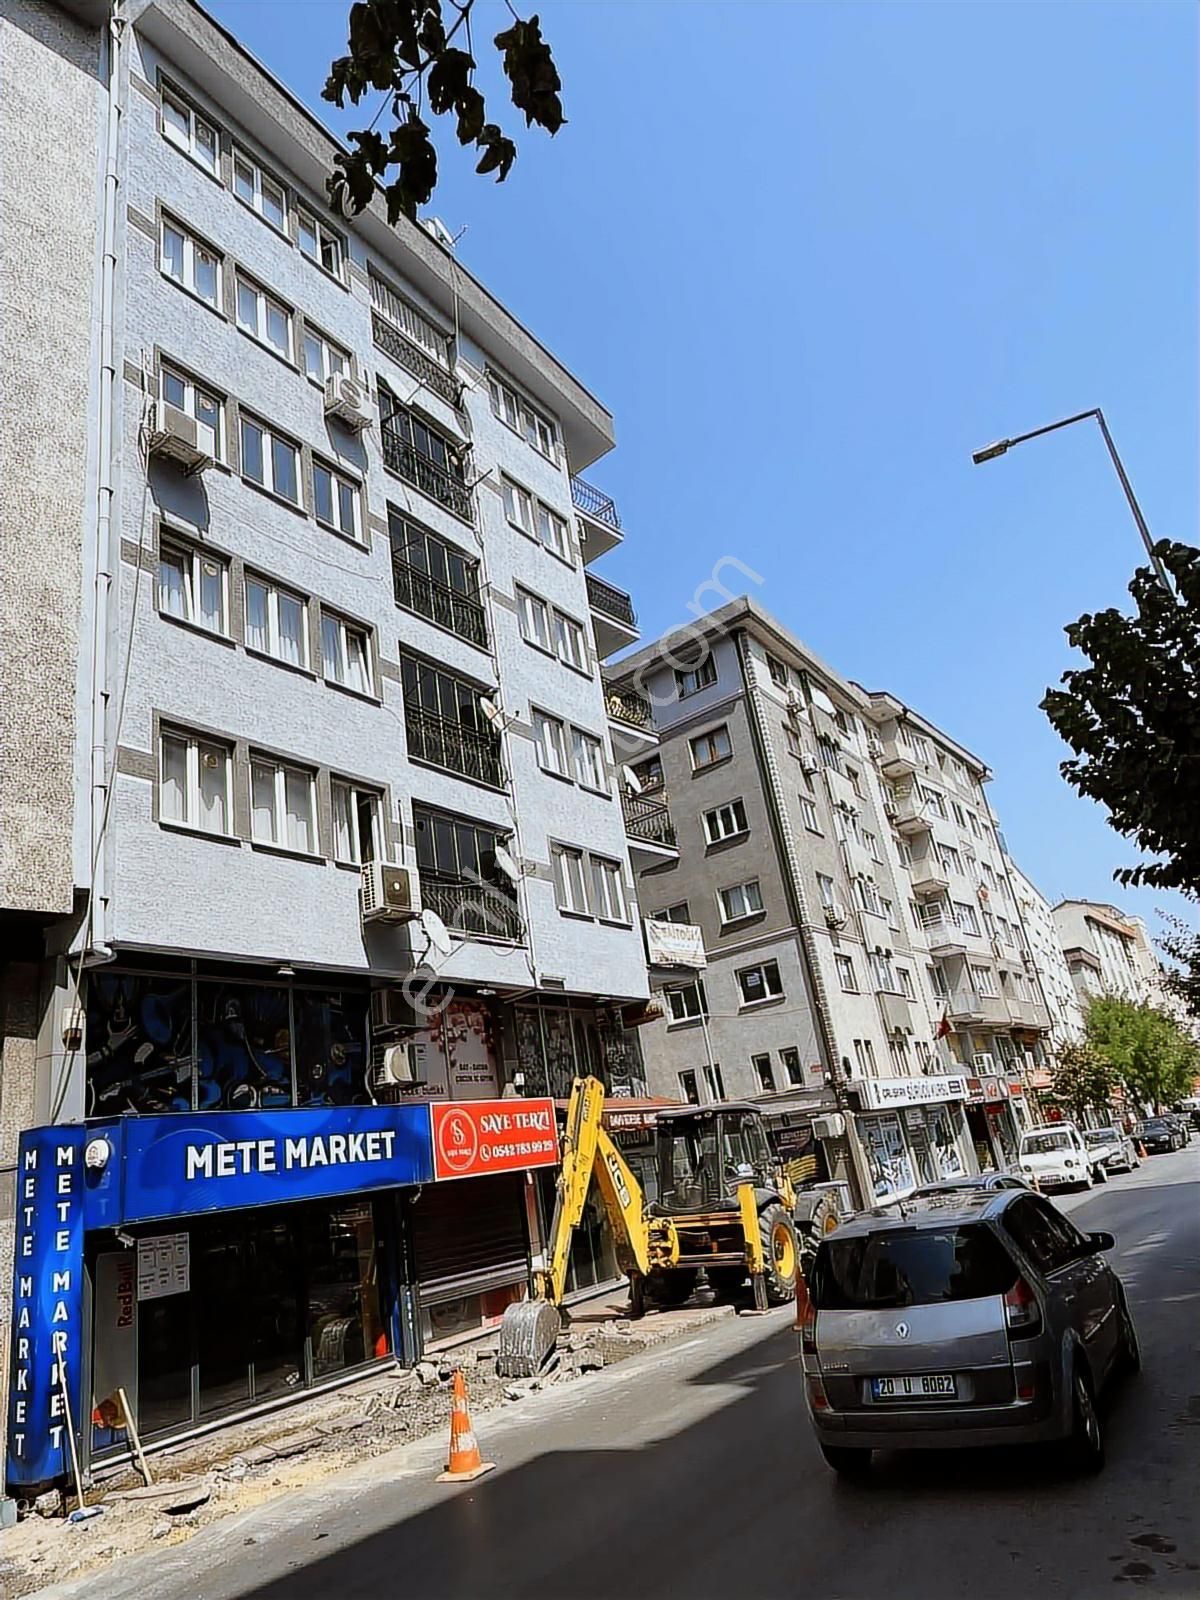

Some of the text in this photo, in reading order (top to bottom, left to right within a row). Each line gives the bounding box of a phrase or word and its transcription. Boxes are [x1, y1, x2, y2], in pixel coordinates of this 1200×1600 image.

[480, 1112, 513, 1135] SAYE
[186, 1130, 396, 1180] METE MARKET
[492, 1144, 515, 1158] 0542
[15, 1149, 37, 1456] METE MARKET
[50, 1146, 73, 1449] METE MARKET
[879, 1379, 895, 1395] 20
[902, 1378, 912, 1394] U
